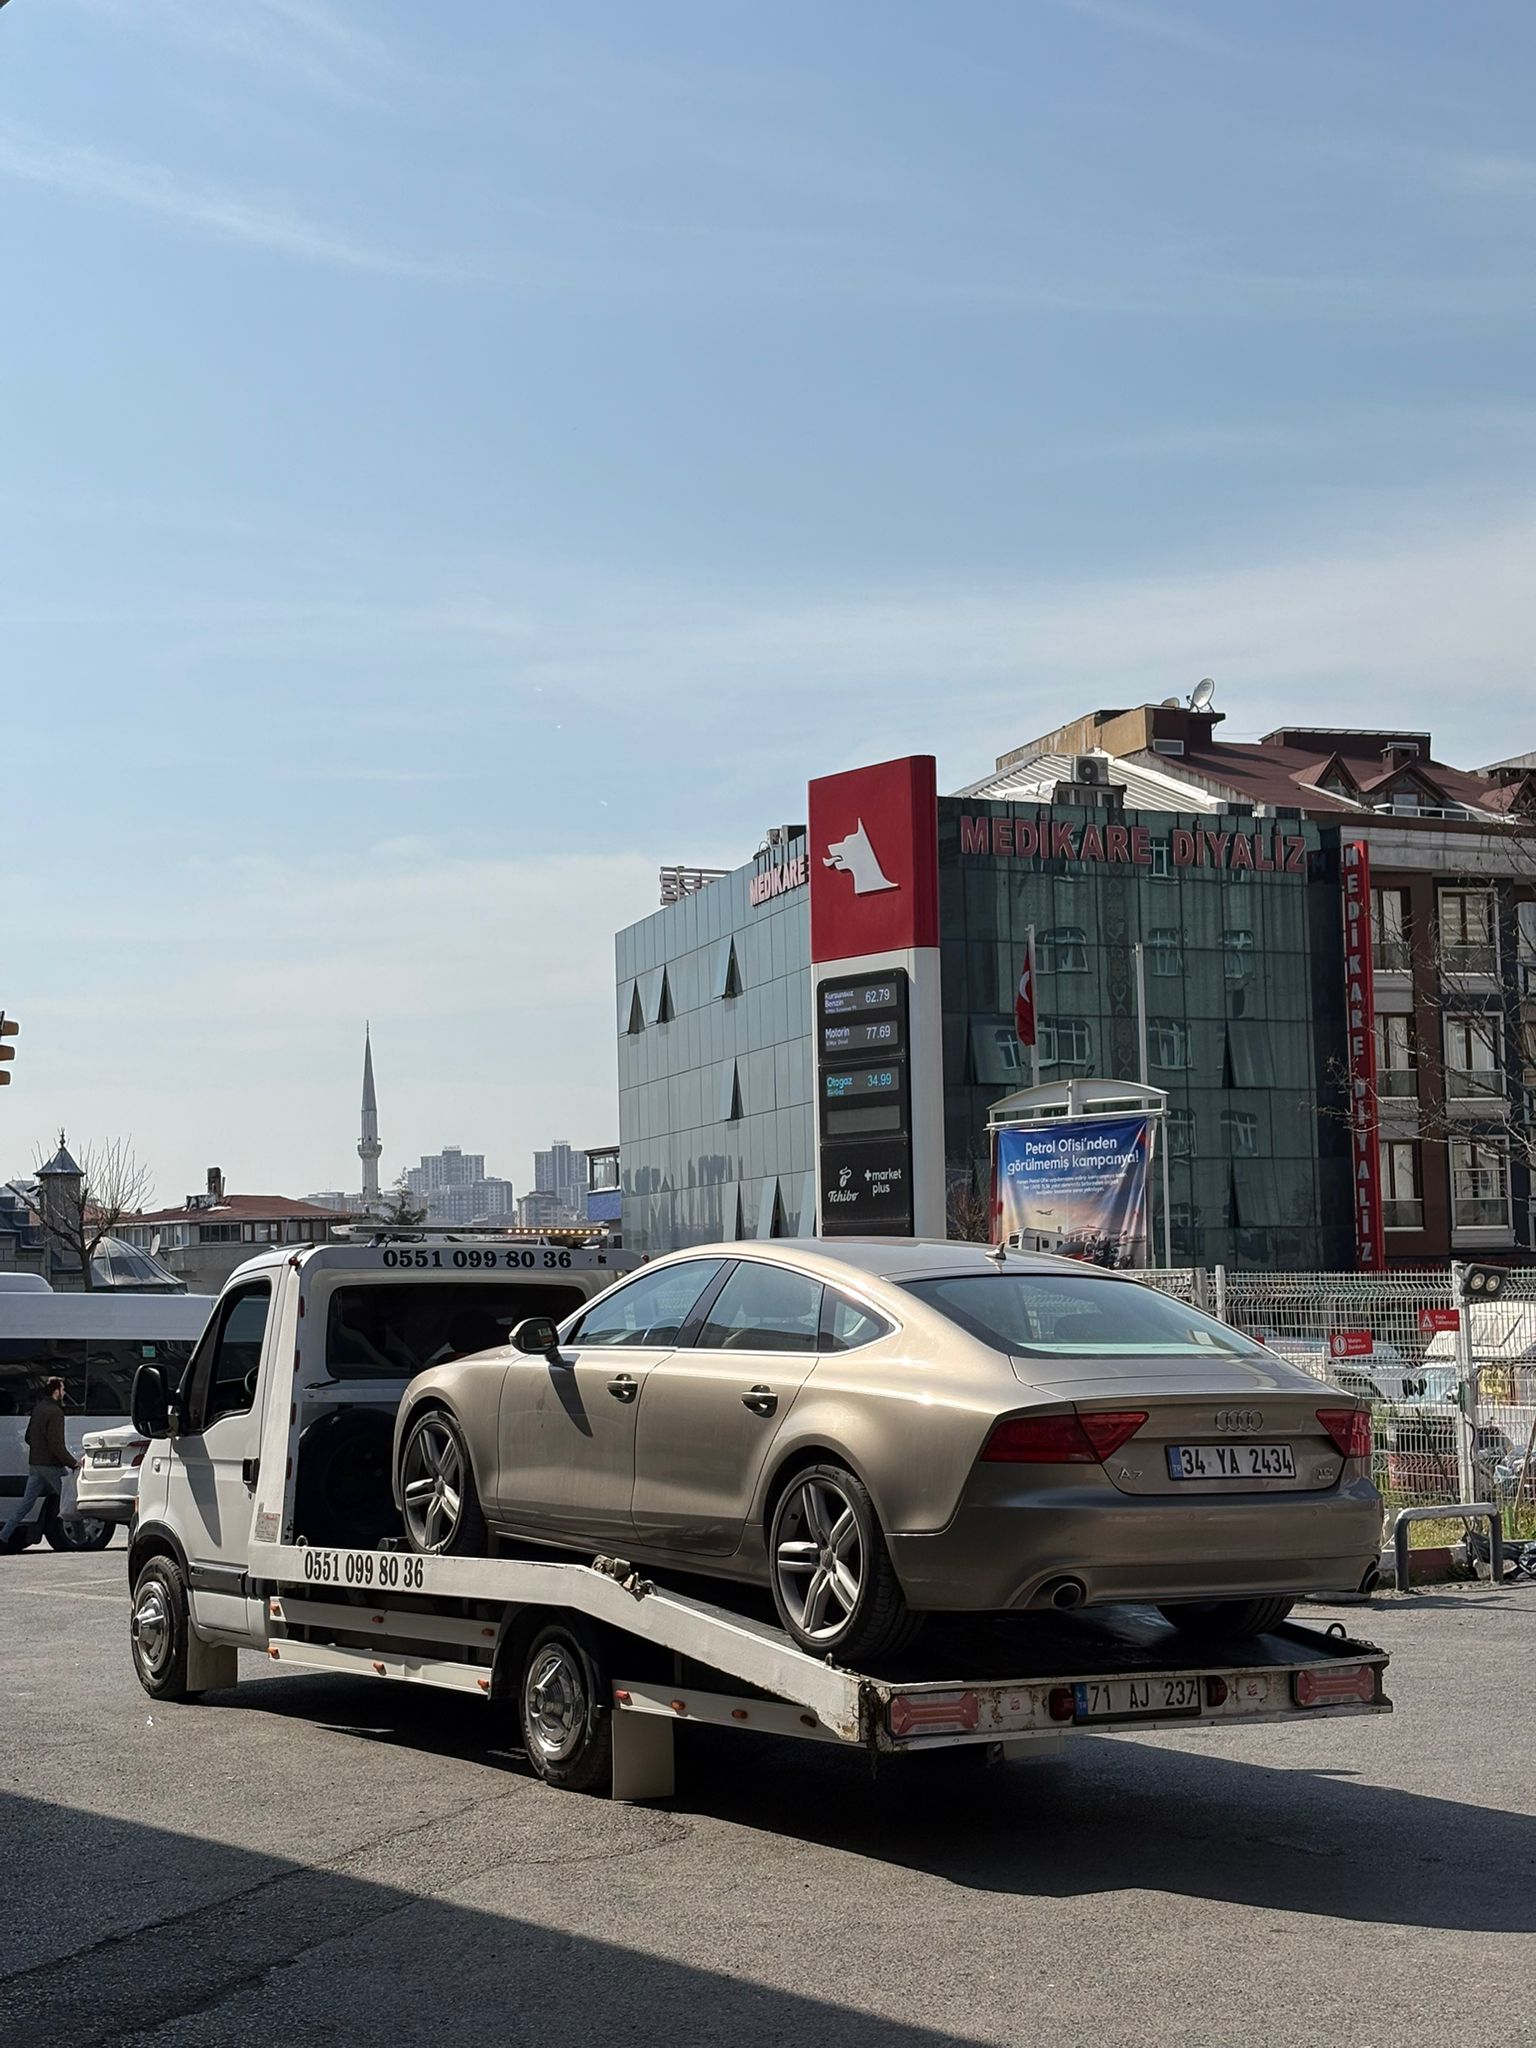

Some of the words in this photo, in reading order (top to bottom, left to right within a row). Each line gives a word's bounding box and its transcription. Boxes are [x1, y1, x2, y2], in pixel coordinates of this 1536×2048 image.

[1172, 820, 1306, 873] DİYALİZ
[865, 988, 890, 1003] 62.79
[825, 1026, 850, 1039] Motorin
[866, 1025, 891, 1040] 77.69
[826, 1076, 853, 1089] Otogaz
[867, 1073, 892, 1087] 34.99
[1025, 1141, 1056, 1156] Petrol
[1007, 1157, 1070, 1175] görülmemiş
[1072, 1149, 1139, 1169] kampanya!
[827, 1190, 860, 1203] Tchibo
[872, 1182, 890, 1197] plus
[382, 1250, 443, 1268] 0551
[453, 1250, 498, 1268] 099
[505, 1250, 536, 1268] 80
[543, 1251, 572, 1268] 36
[1181, 1449, 1206, 1474] 34
[1216, 1448, 1240, 1474] YA
[1250, 1449, 1292, 1474] 2434
[1119, 1467, 1144, 1481] A7
[304, 1550, 340, 1582] 0551
[345, 1554, 373, 1585] 099
[379, 1555, 399, 1587] 80
[403, 1557, 424, 1589] 36
[1090, 1684, 1111, 1712] 71
[1129, 1682, 1149, 1709] AJ
[1164, 1679, 1195, 1706] 237
